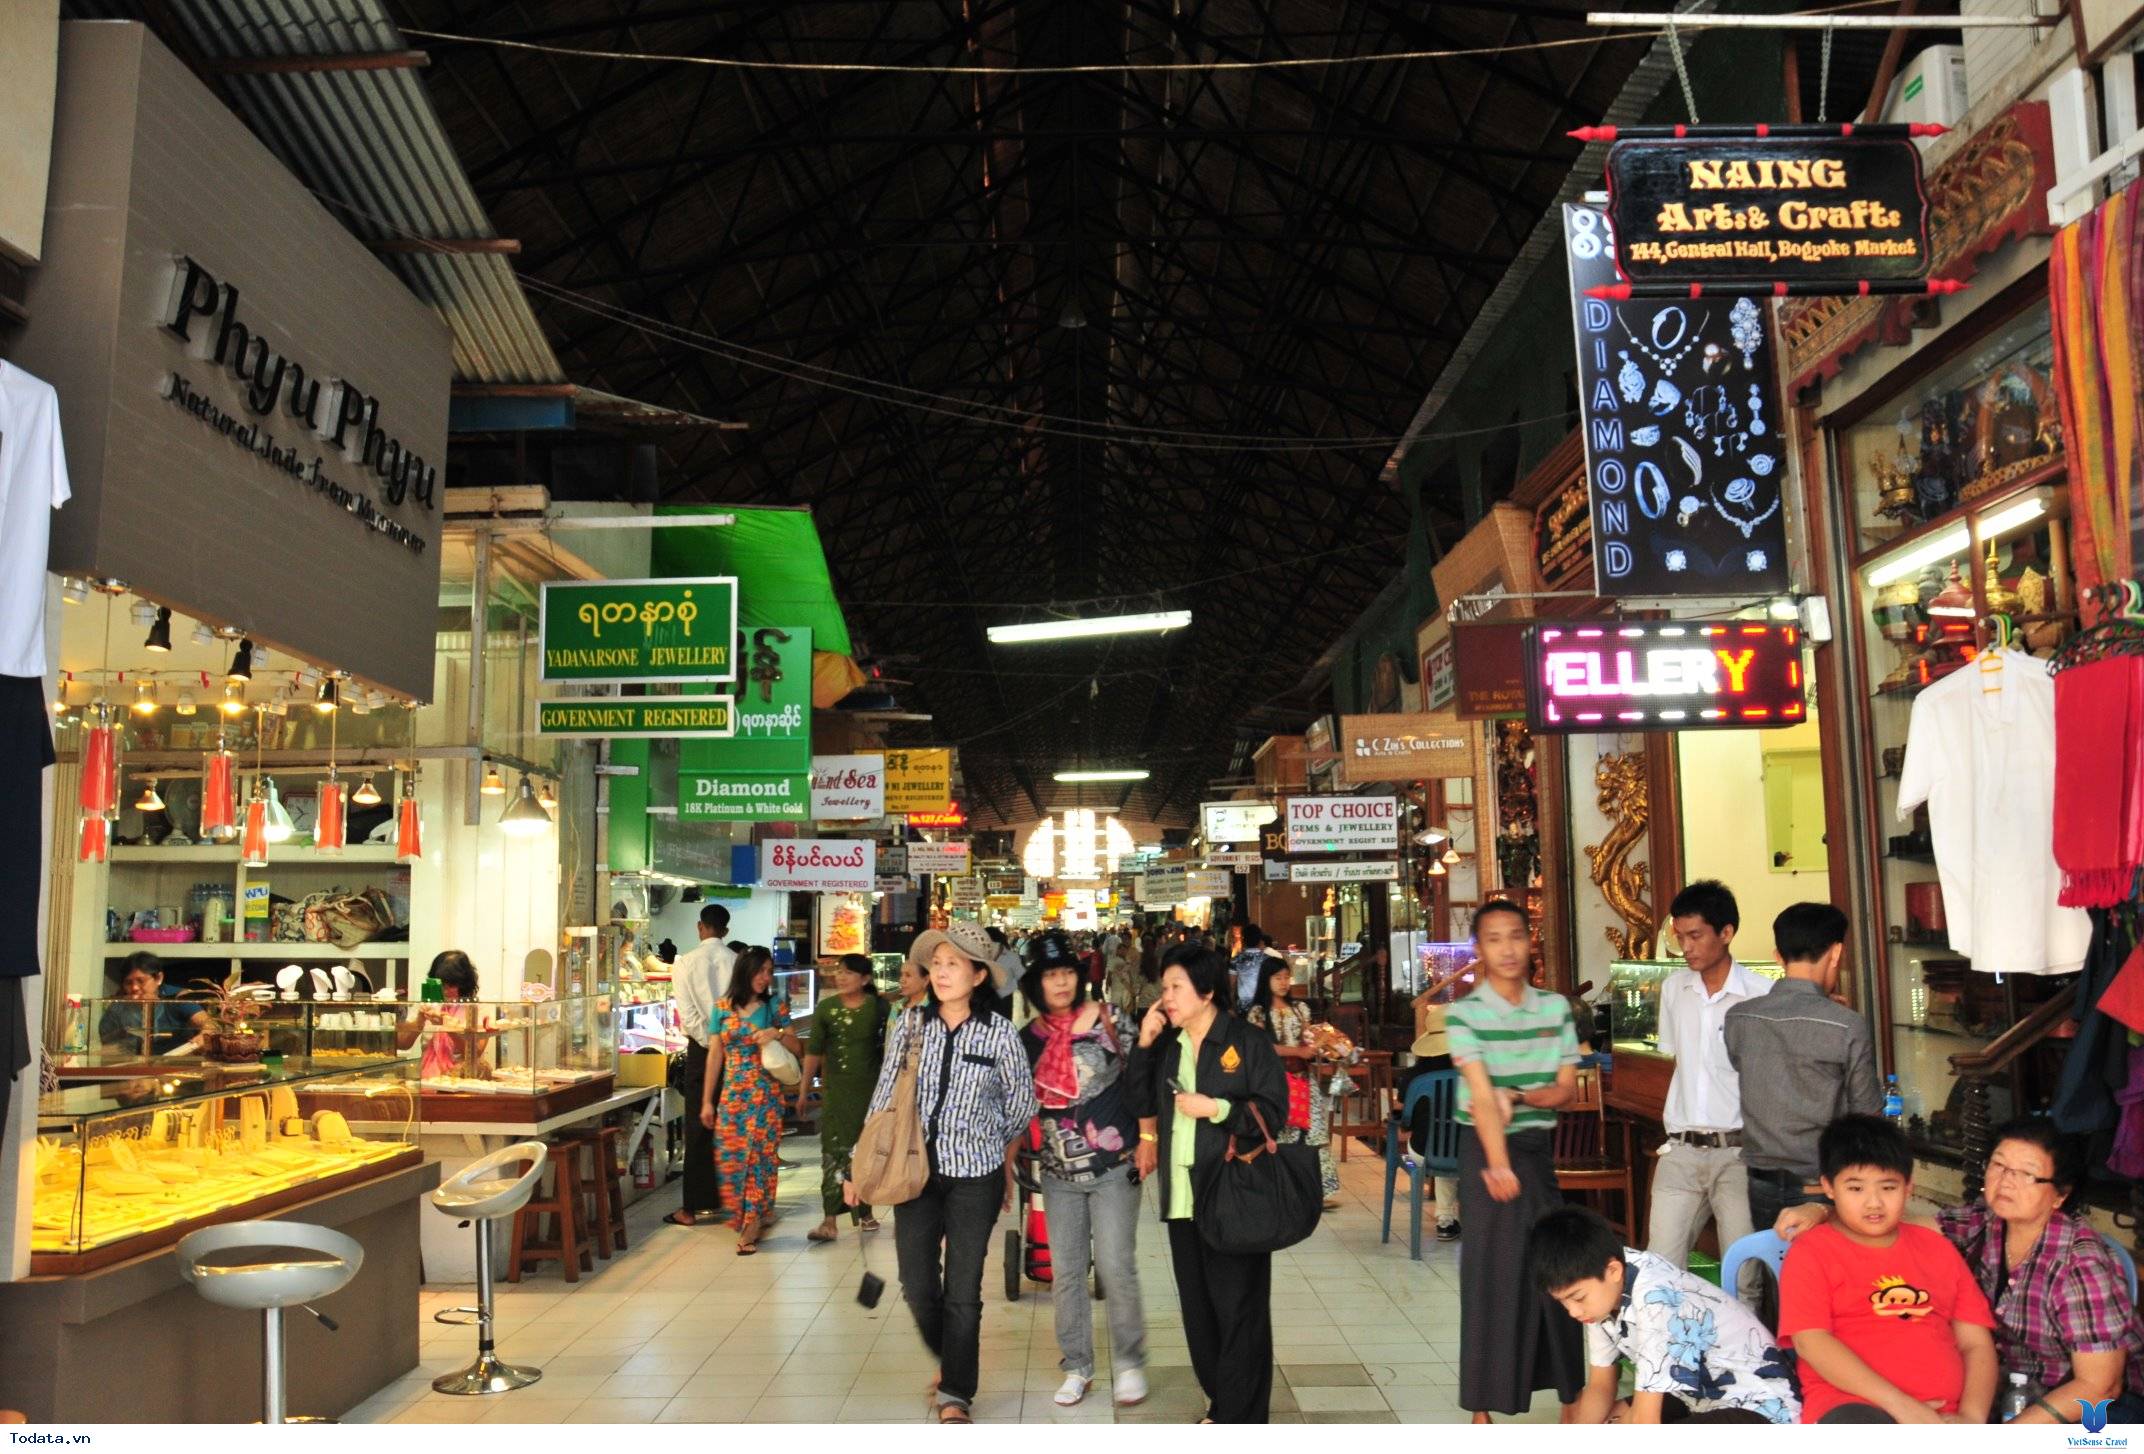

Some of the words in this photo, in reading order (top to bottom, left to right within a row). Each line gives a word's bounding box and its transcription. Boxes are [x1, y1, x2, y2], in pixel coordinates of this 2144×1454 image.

[1688, 159, 1847, 190] NAING
[1778, 200, 1901, 231] Crafts
[1855, 238, 1917, 257] Market
[167, 254, 321, 430] Phyu
[331, 377, 436, 511] Phyu
[168, 371, 259, 452] Natural
[258, 433, 305, 479] Jade
[308, 456, 352, 506] from
[1583, 298, 1634, 577] DIAMOND
[547, 647, 640, 668] YADANARSONE
[650, 645, 728, 666] JEWELLERY
[541, 708, 636, 728] GOVERNMENT
[643, 707, 728, 727] REGISTERED
[695, 778, 791, 797] Diamond
[844, 768, 878, 789] Sea
[902, 782, 945, 791] JEWELLERY
[684, 802, 703, 814] 18K
[704, 802, 744, 814] Platinum
[745, 802, 753, 814] &
[755, 802, 781, 814] White
[782, 802, 804, 814] Gold
[821, 795, 871, 809] Jewellery
[1291, 803, 1324, 820] TOP
[1331, 802, 1394, 819] CHOICE
[1291, 823, 1320, 833] GEMS
[1325, 824, 1333, 833] &
[1338, 822, 1394, 833] JEWELLERY
[1290, 838, 1345, 846] GOVERNMENT
[772, 844, 864, 875] စိန်ပင်လယ်
[767, 879, 818, 888] GOVERNMENT
[822, 879, 869, 888] REGISTERED
